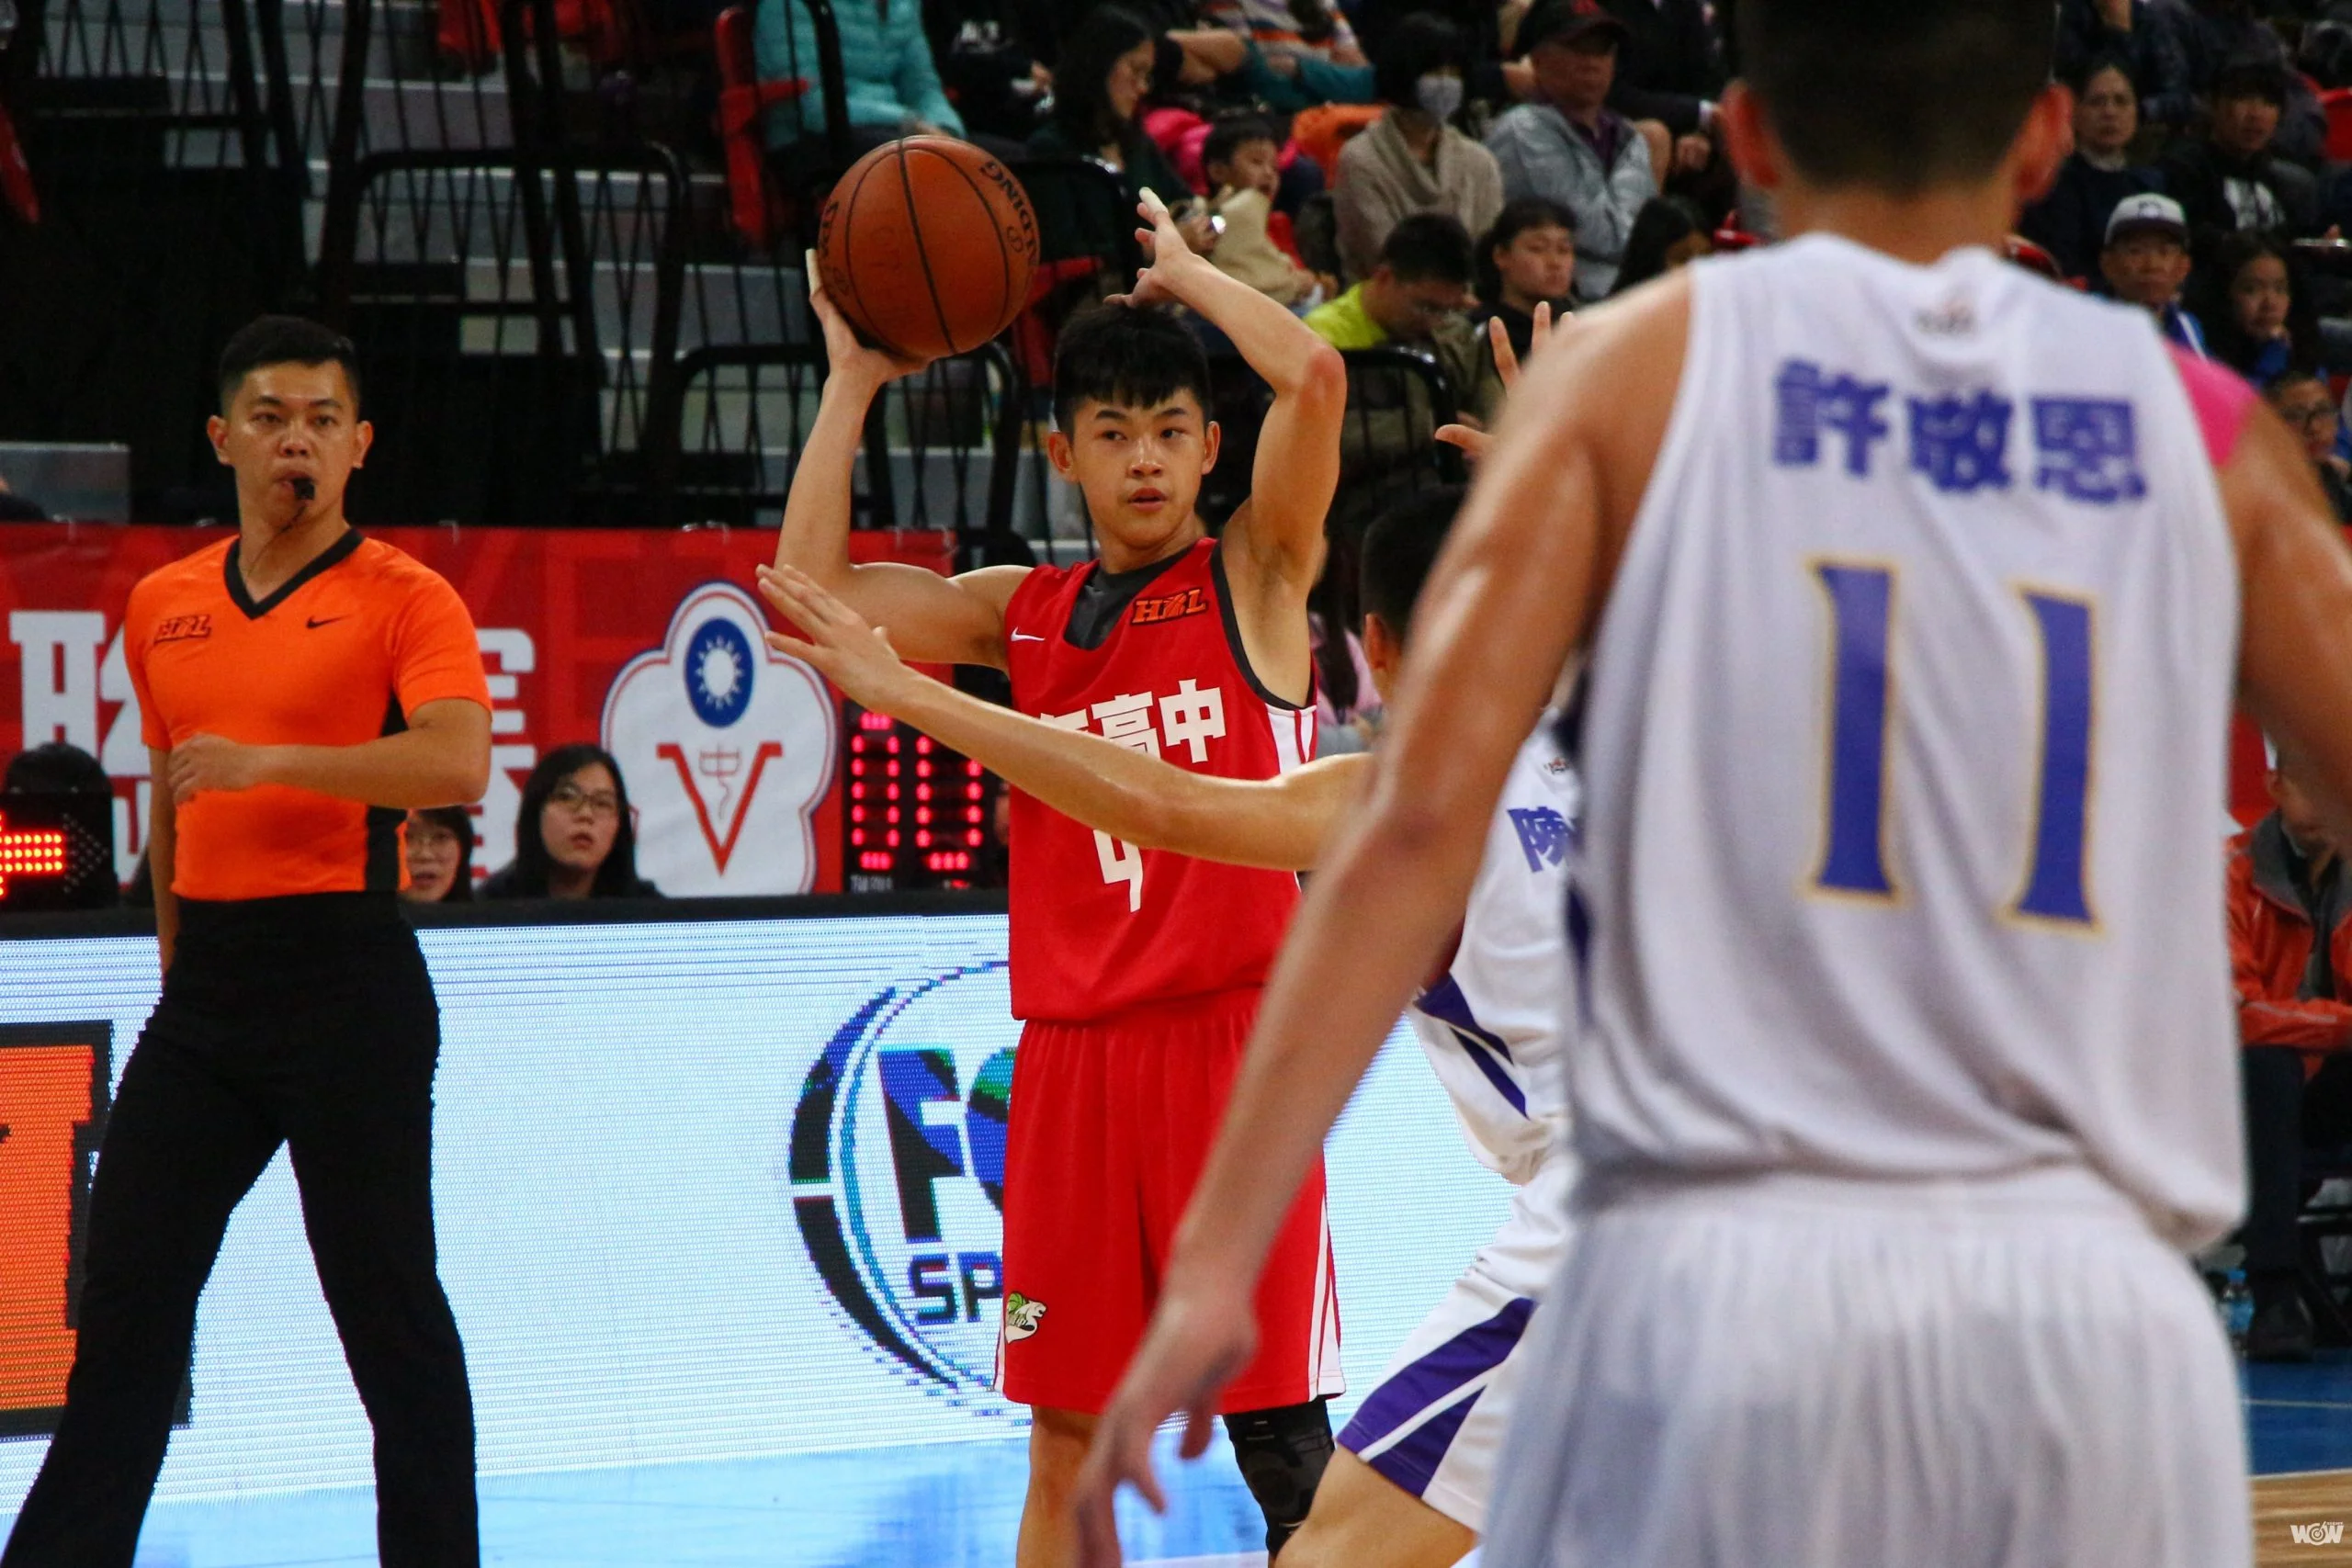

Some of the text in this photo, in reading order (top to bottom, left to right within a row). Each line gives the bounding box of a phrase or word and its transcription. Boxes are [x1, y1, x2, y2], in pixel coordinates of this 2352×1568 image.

[1771, 358, 2148, 505] 許敬恩
[1131, 588, 1207, 626] HBL
[1038, 678, 1227, 764] 高中
[1803, 553, 2104, 937] 11
